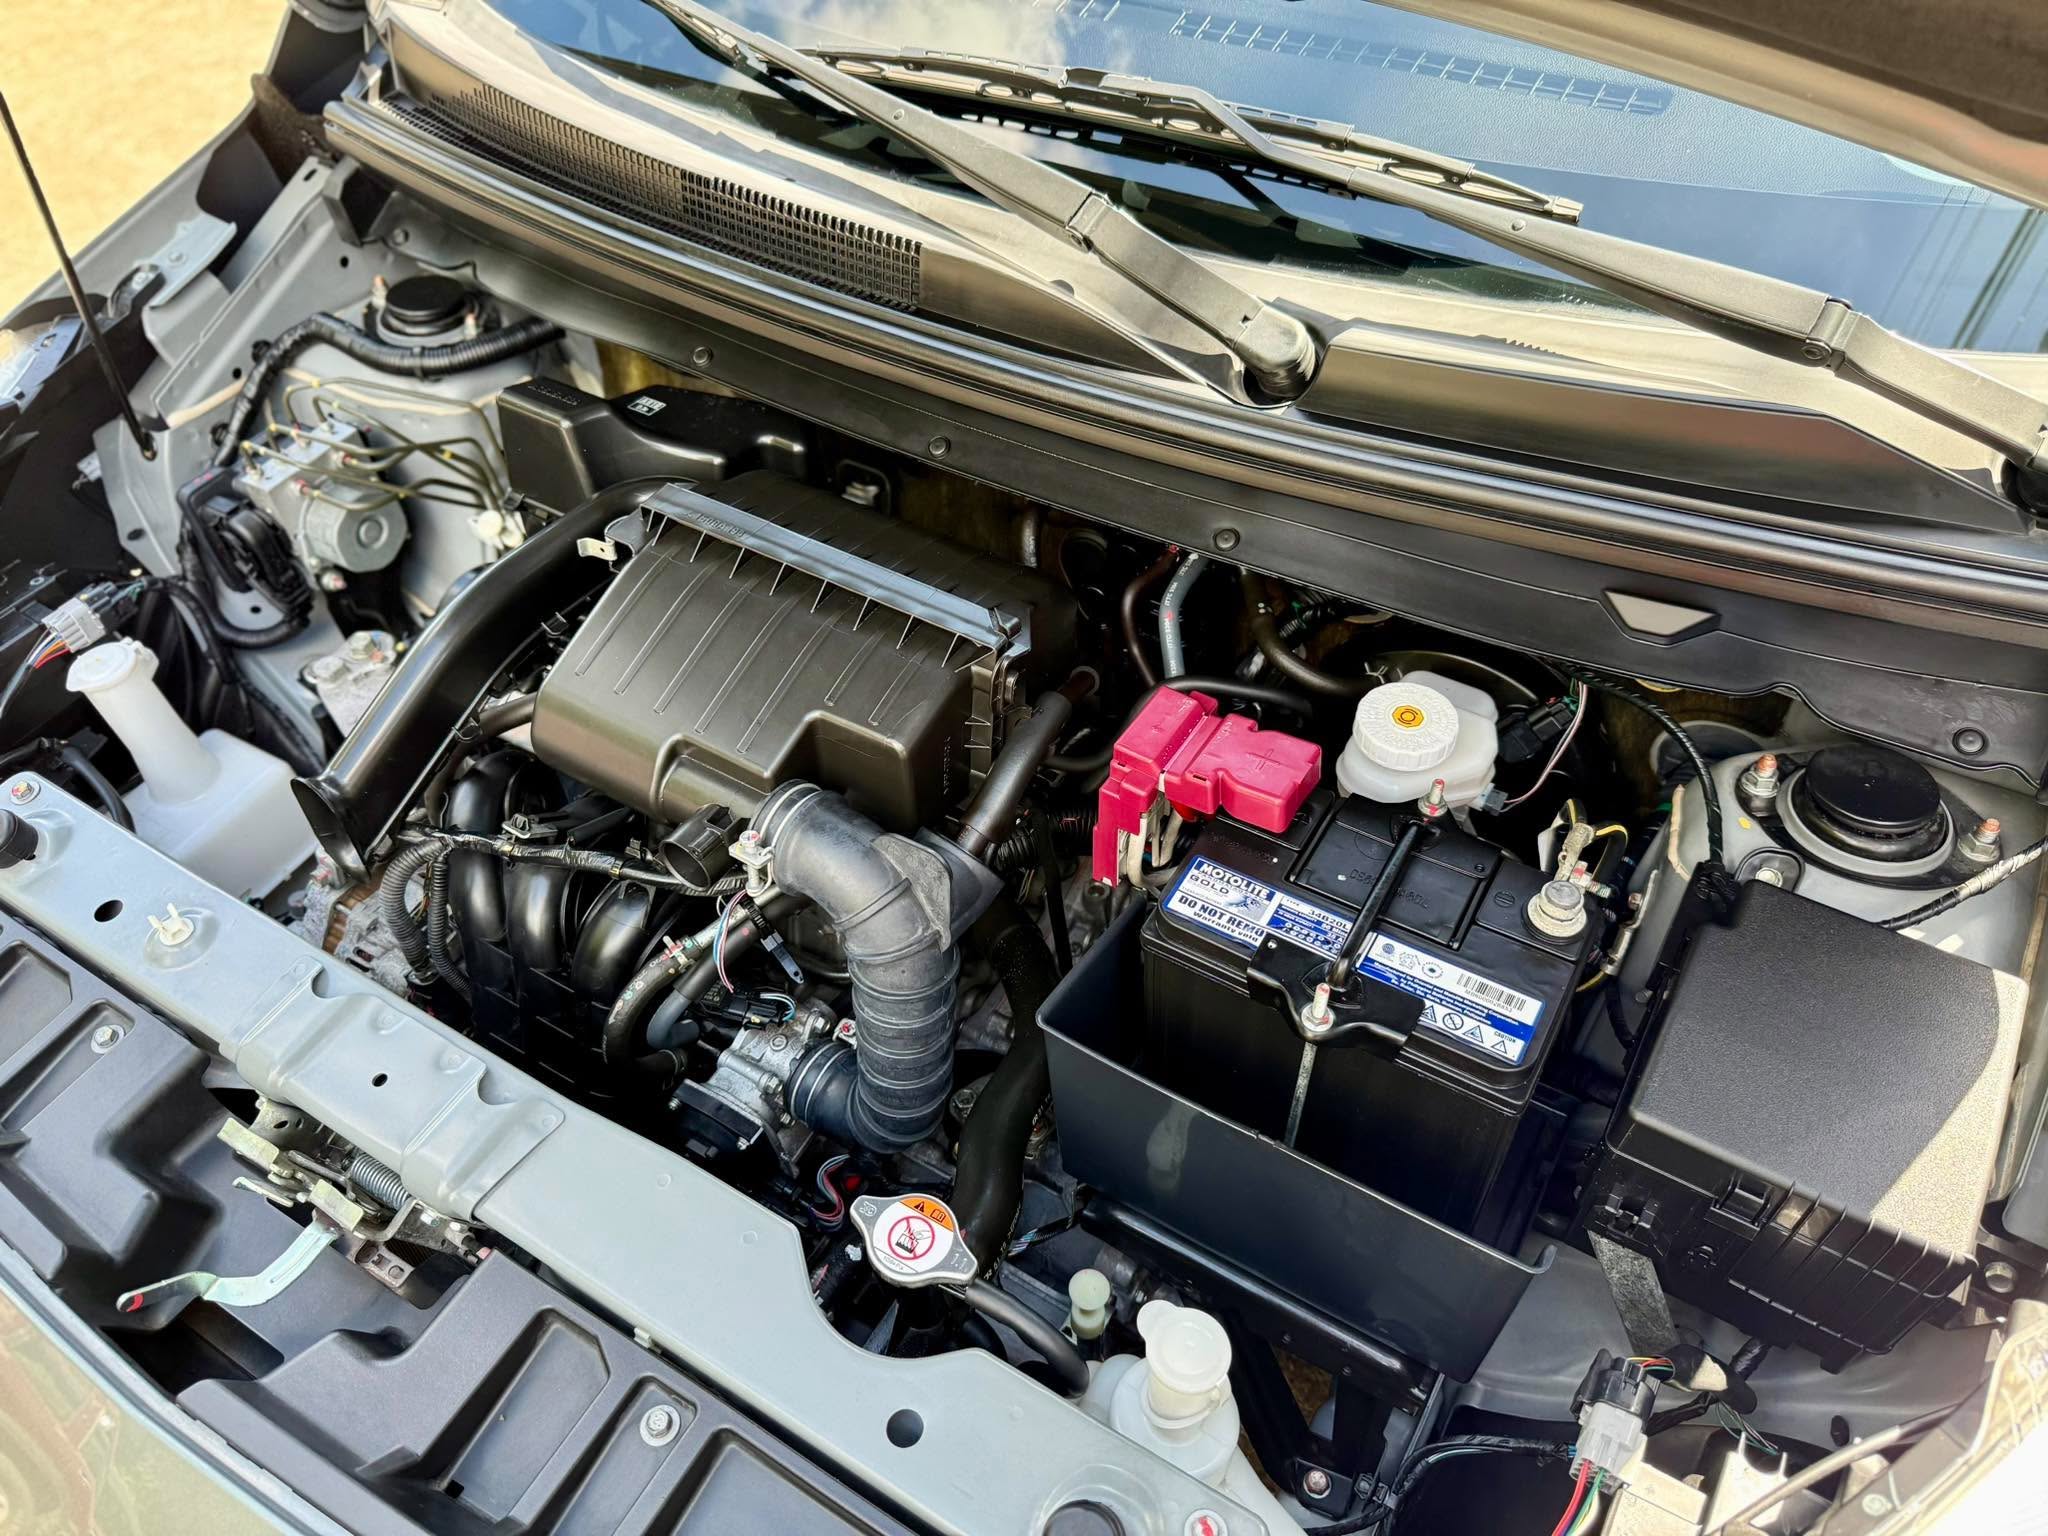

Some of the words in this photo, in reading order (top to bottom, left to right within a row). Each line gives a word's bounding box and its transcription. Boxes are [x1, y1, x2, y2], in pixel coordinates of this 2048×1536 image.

[1190, 874, 1230, 895] GOLD
[1200, 863, 1270, 900] MOTOLITE
[1178, 895, 1198, 909] DO
[1200, 904, 1228, 919] NOT
[1226, 916, 1266, 937] REMO
[1193, 911, 1237, 934] Warranty
[1494, 1031, 1516, 1043] CAUTION
